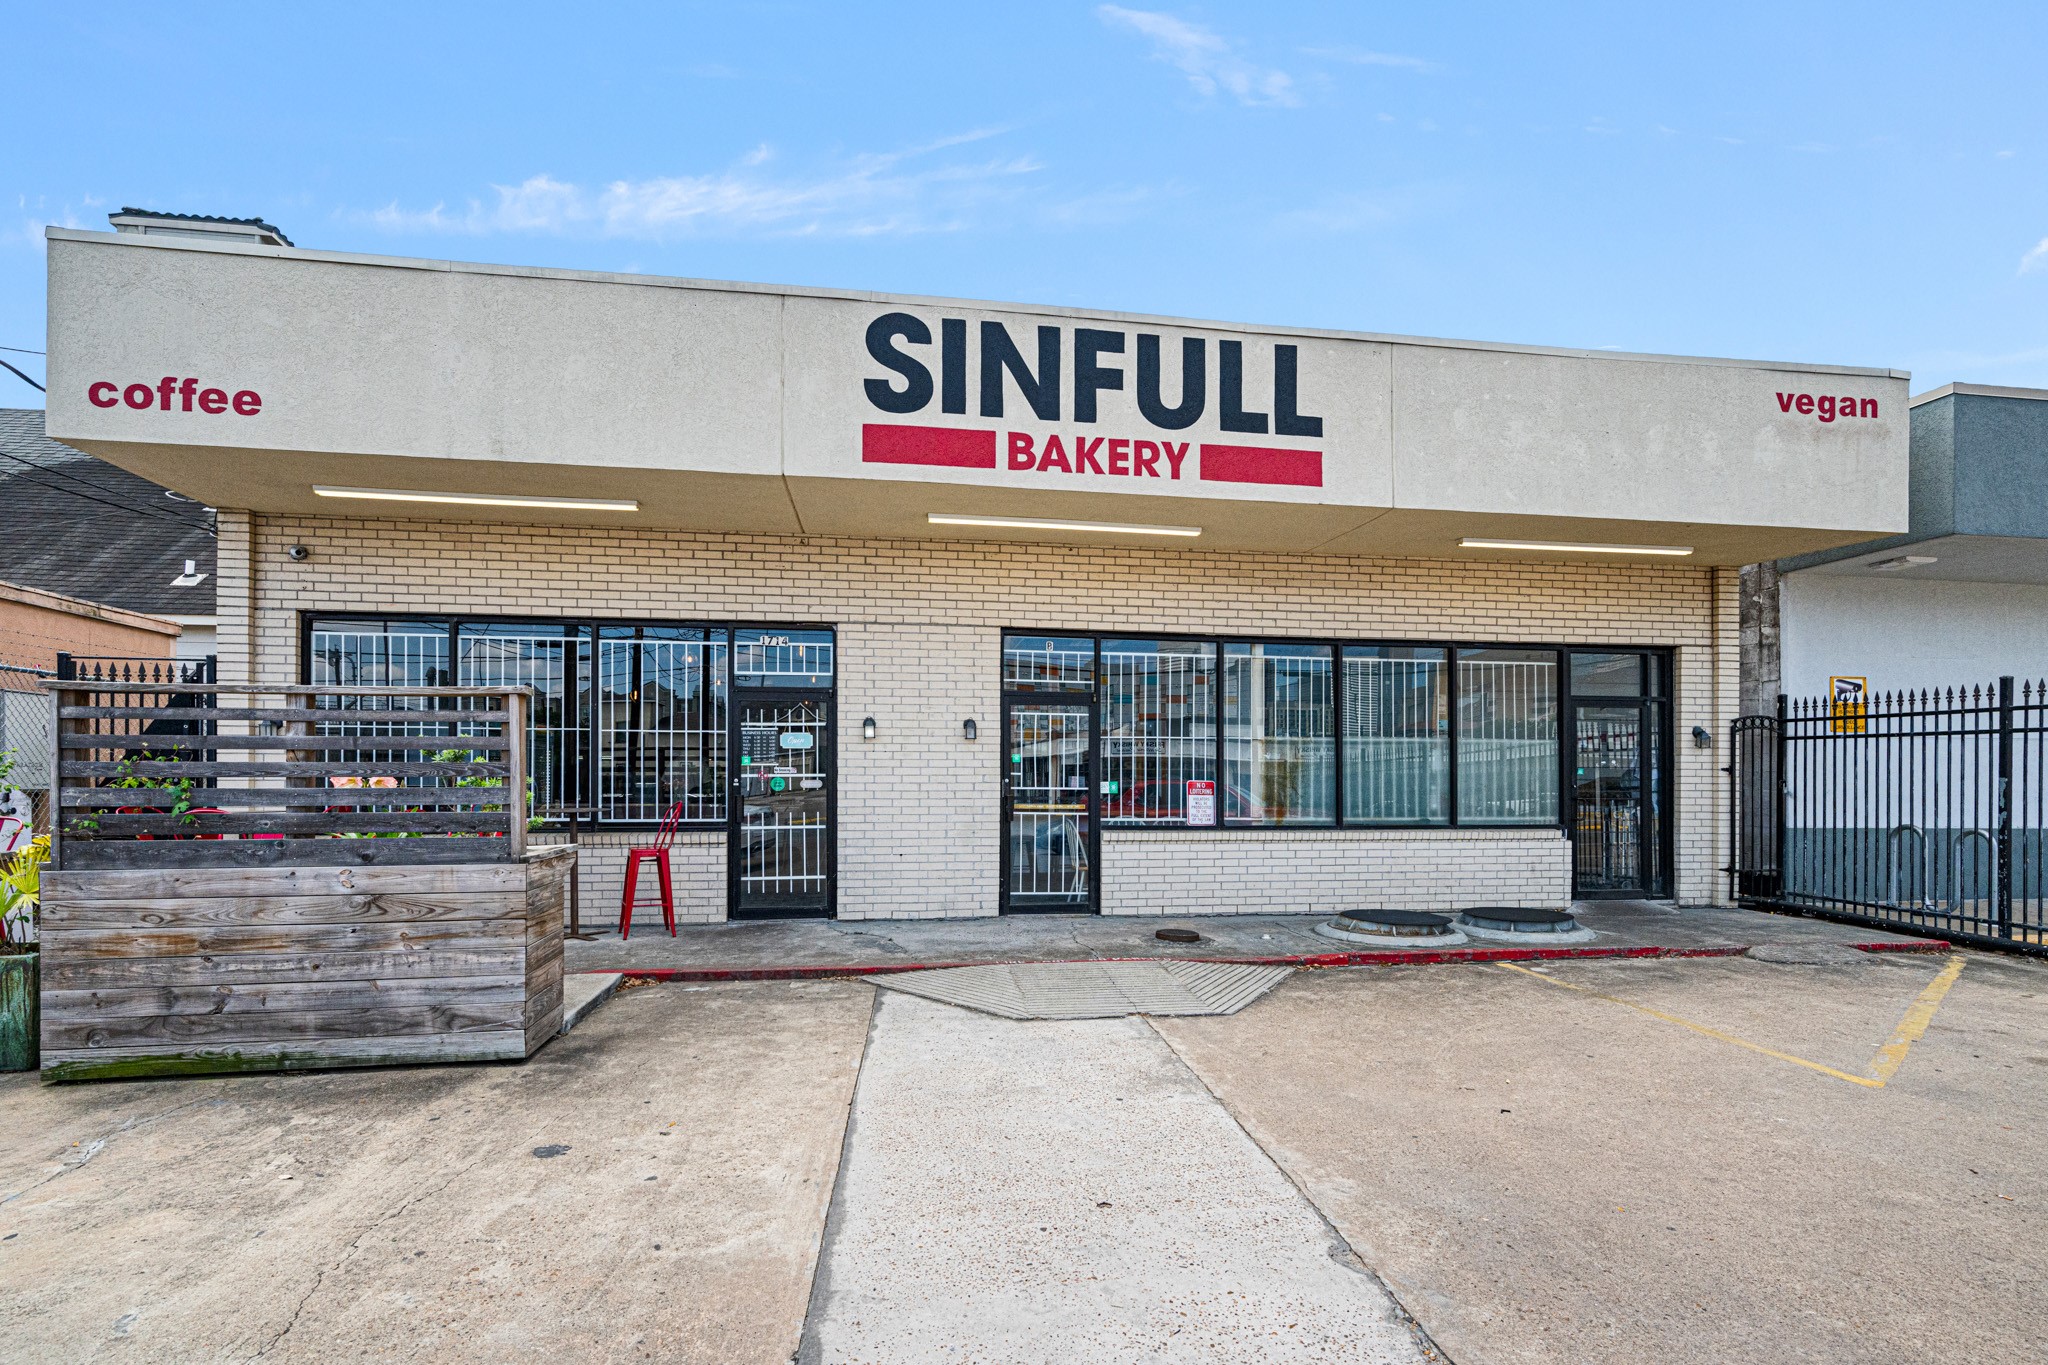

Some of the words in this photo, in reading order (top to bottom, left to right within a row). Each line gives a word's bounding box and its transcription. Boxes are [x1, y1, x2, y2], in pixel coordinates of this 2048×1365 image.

[864, 312, 1323, 437] SINFULL
[88, 376, 262, 416] coffee
[1775, 392, 1879, 422] vegan
[1007, 432, 1190, 480] BAKERY
[761, 636, 788, 646] 1714
[787, 736, 805, 745] Open
